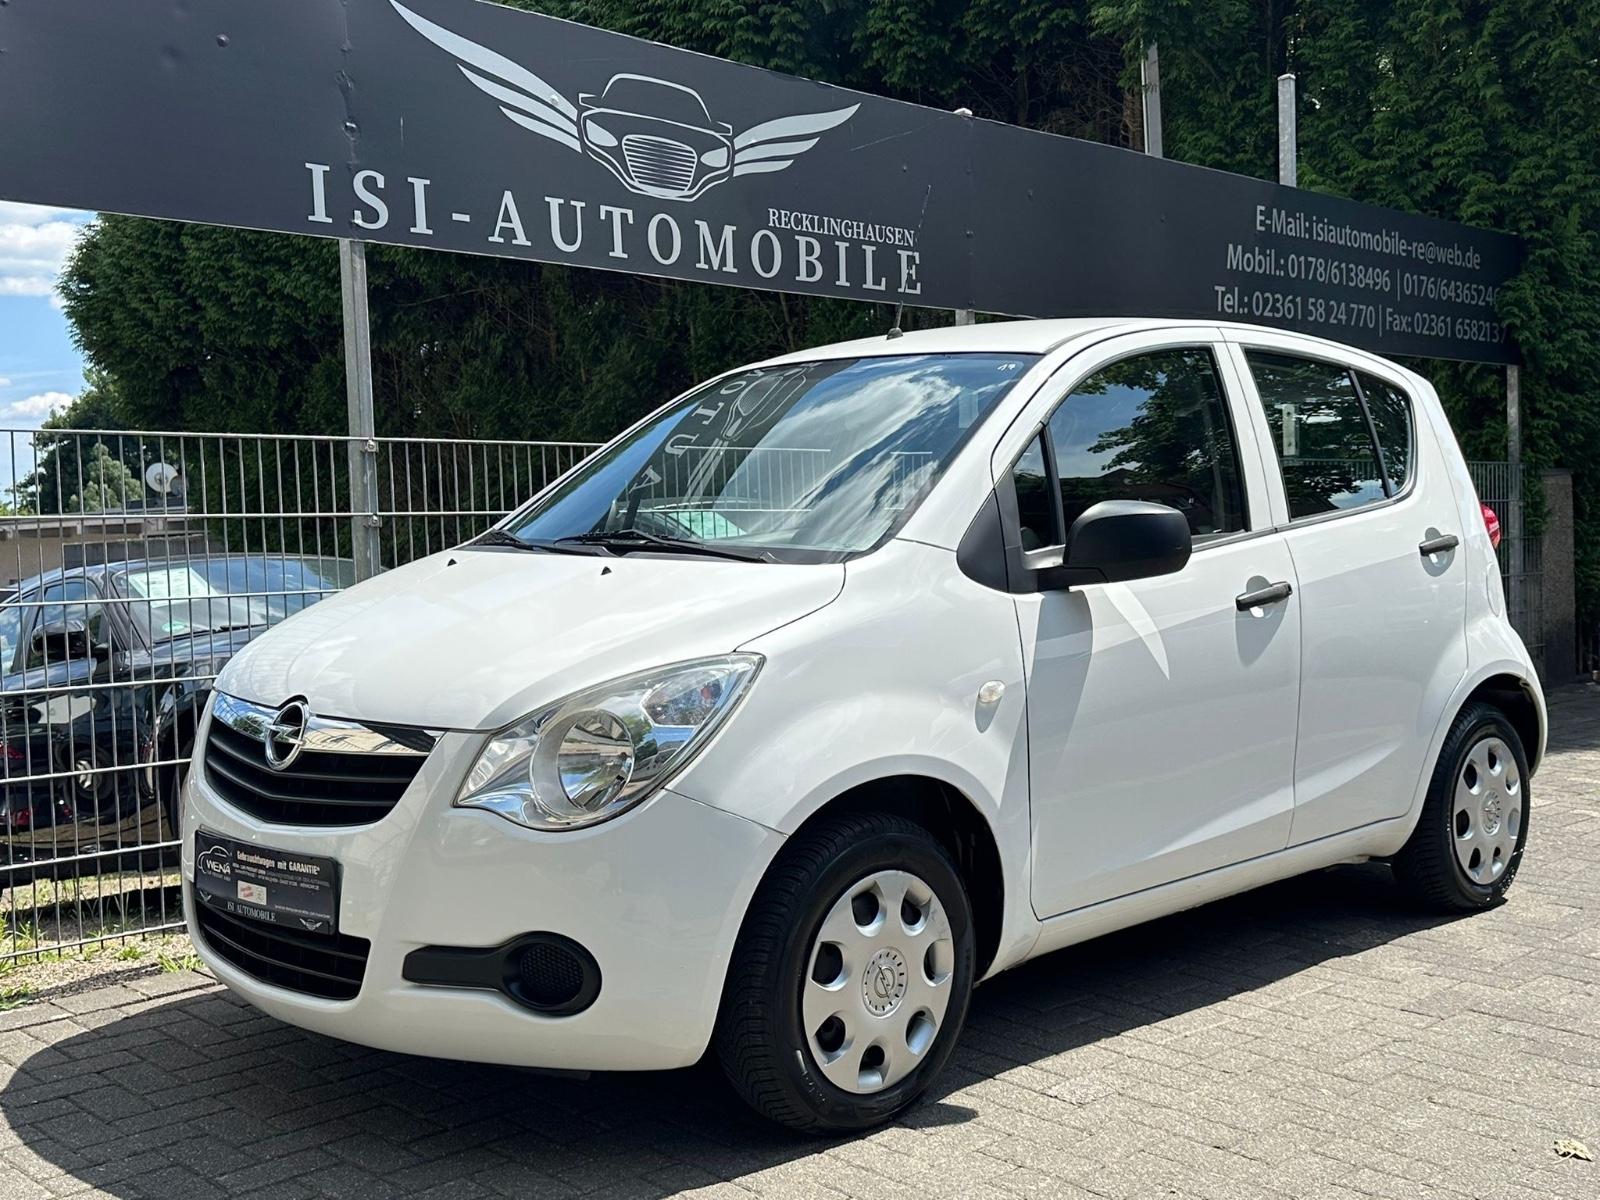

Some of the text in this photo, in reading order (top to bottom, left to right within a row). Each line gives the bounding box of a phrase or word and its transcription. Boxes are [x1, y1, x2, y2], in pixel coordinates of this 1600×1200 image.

[305, 162, 923, 296] ISI-AUTOMOBILE
[768, 208, 916, 247] RECKLINGHAUSEN
[1256, 204, 1481, 271] E-Mail: isiautomobile-re@web.de
[1226, 243, 1285, 278] Mobil.:
[1288, 253, 1391, 293] 0178/6138496
[1214, 285, 1249, 315] Tel.:
[1252, 290, 1303, 320] 02361
[1307, 297, 1326, 322] 58
[1329, 300, 1347, 326] 24
[1350, 303, 1376, 329] 770
[1385, 307, 1412, 334] Fax:
[1414, 312, 1452, 338] 02361
[277, 860, 287, 870] mit
[227, 901, 235, 912] ISI
[237, 904, 277, 922] AUTOMOBILE
